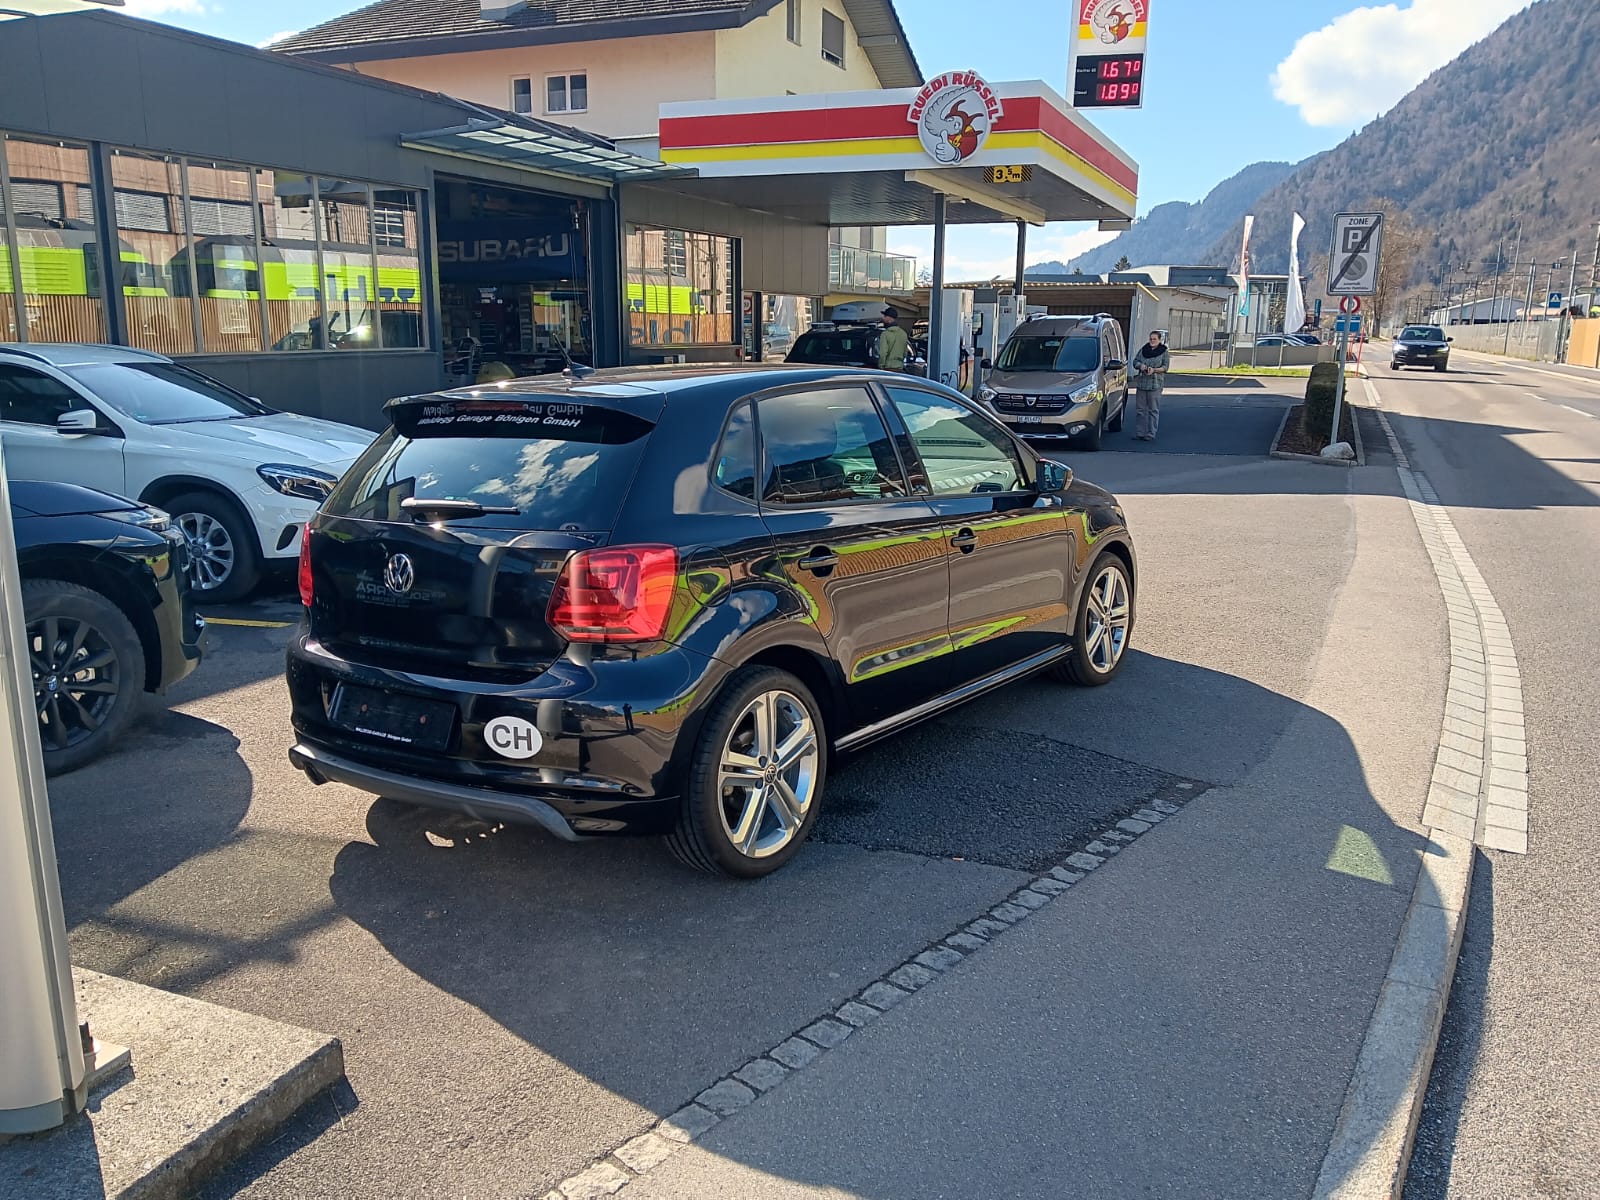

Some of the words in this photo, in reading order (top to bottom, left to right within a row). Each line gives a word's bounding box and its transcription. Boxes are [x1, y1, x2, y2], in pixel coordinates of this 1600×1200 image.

[910, 75, 948, 120] RUEDI
[952, 70, 998, 120] RÜSSEL
[1348, 217, 1369, 226] ZONE
[438, 233, 569, 262] SUBARU
[1347, 229, 1363, 250] P
[457, 414, 493, 423] Garage
[495, 414, 539, 425] Bönigen
[542, 416, 581, 428] GmbH
[491, 724, 533, 751] CH
